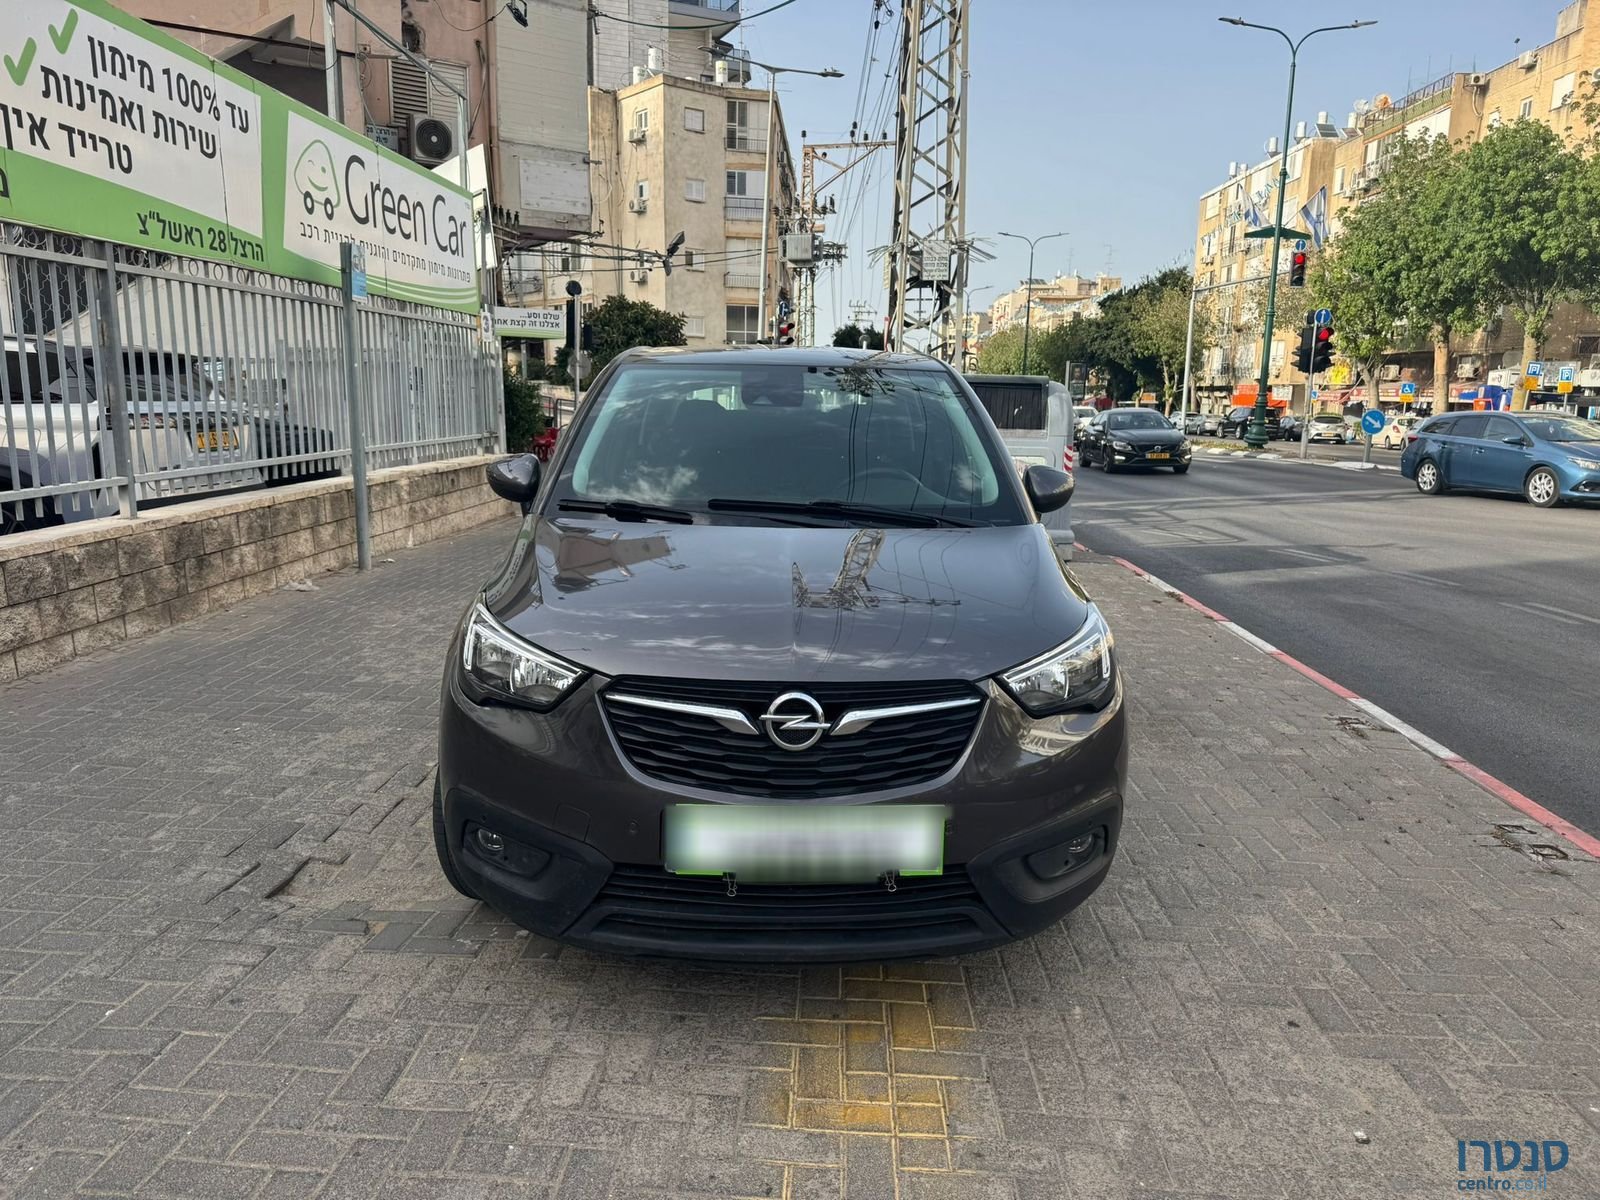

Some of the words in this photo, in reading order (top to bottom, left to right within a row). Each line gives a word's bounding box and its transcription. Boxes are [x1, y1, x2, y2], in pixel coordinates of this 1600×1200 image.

[87, 35, 155, 93] מימון
[40, 65, 146, 134] ואמינות
[162, 67, 221, 122] 100%
[0, 103, 50, 151] אין
[224, 100, 250, 134] עד
[58, 122, 133, 174] טרייד
[152, 109, 217, 159] שירות
[344, 154, 428, 246] Green
[432, 194, 467, 258] Car
[136, 210, 204, 248] ראשל"צ
[207, 226, 227, 253] 28
[299, 221, 320, 241] רכב
[229, 231, 265, 262] הרצל
[392, 251, 427, 271] מתקדמים
[428, 260, 446, 279] מימון
[447, 265, 471, 283] פתרונות
[509, 319, 527, 328] קצת
[540, 320, 560, 328] אצלנו
[542, 311, 560, 320] שלם
